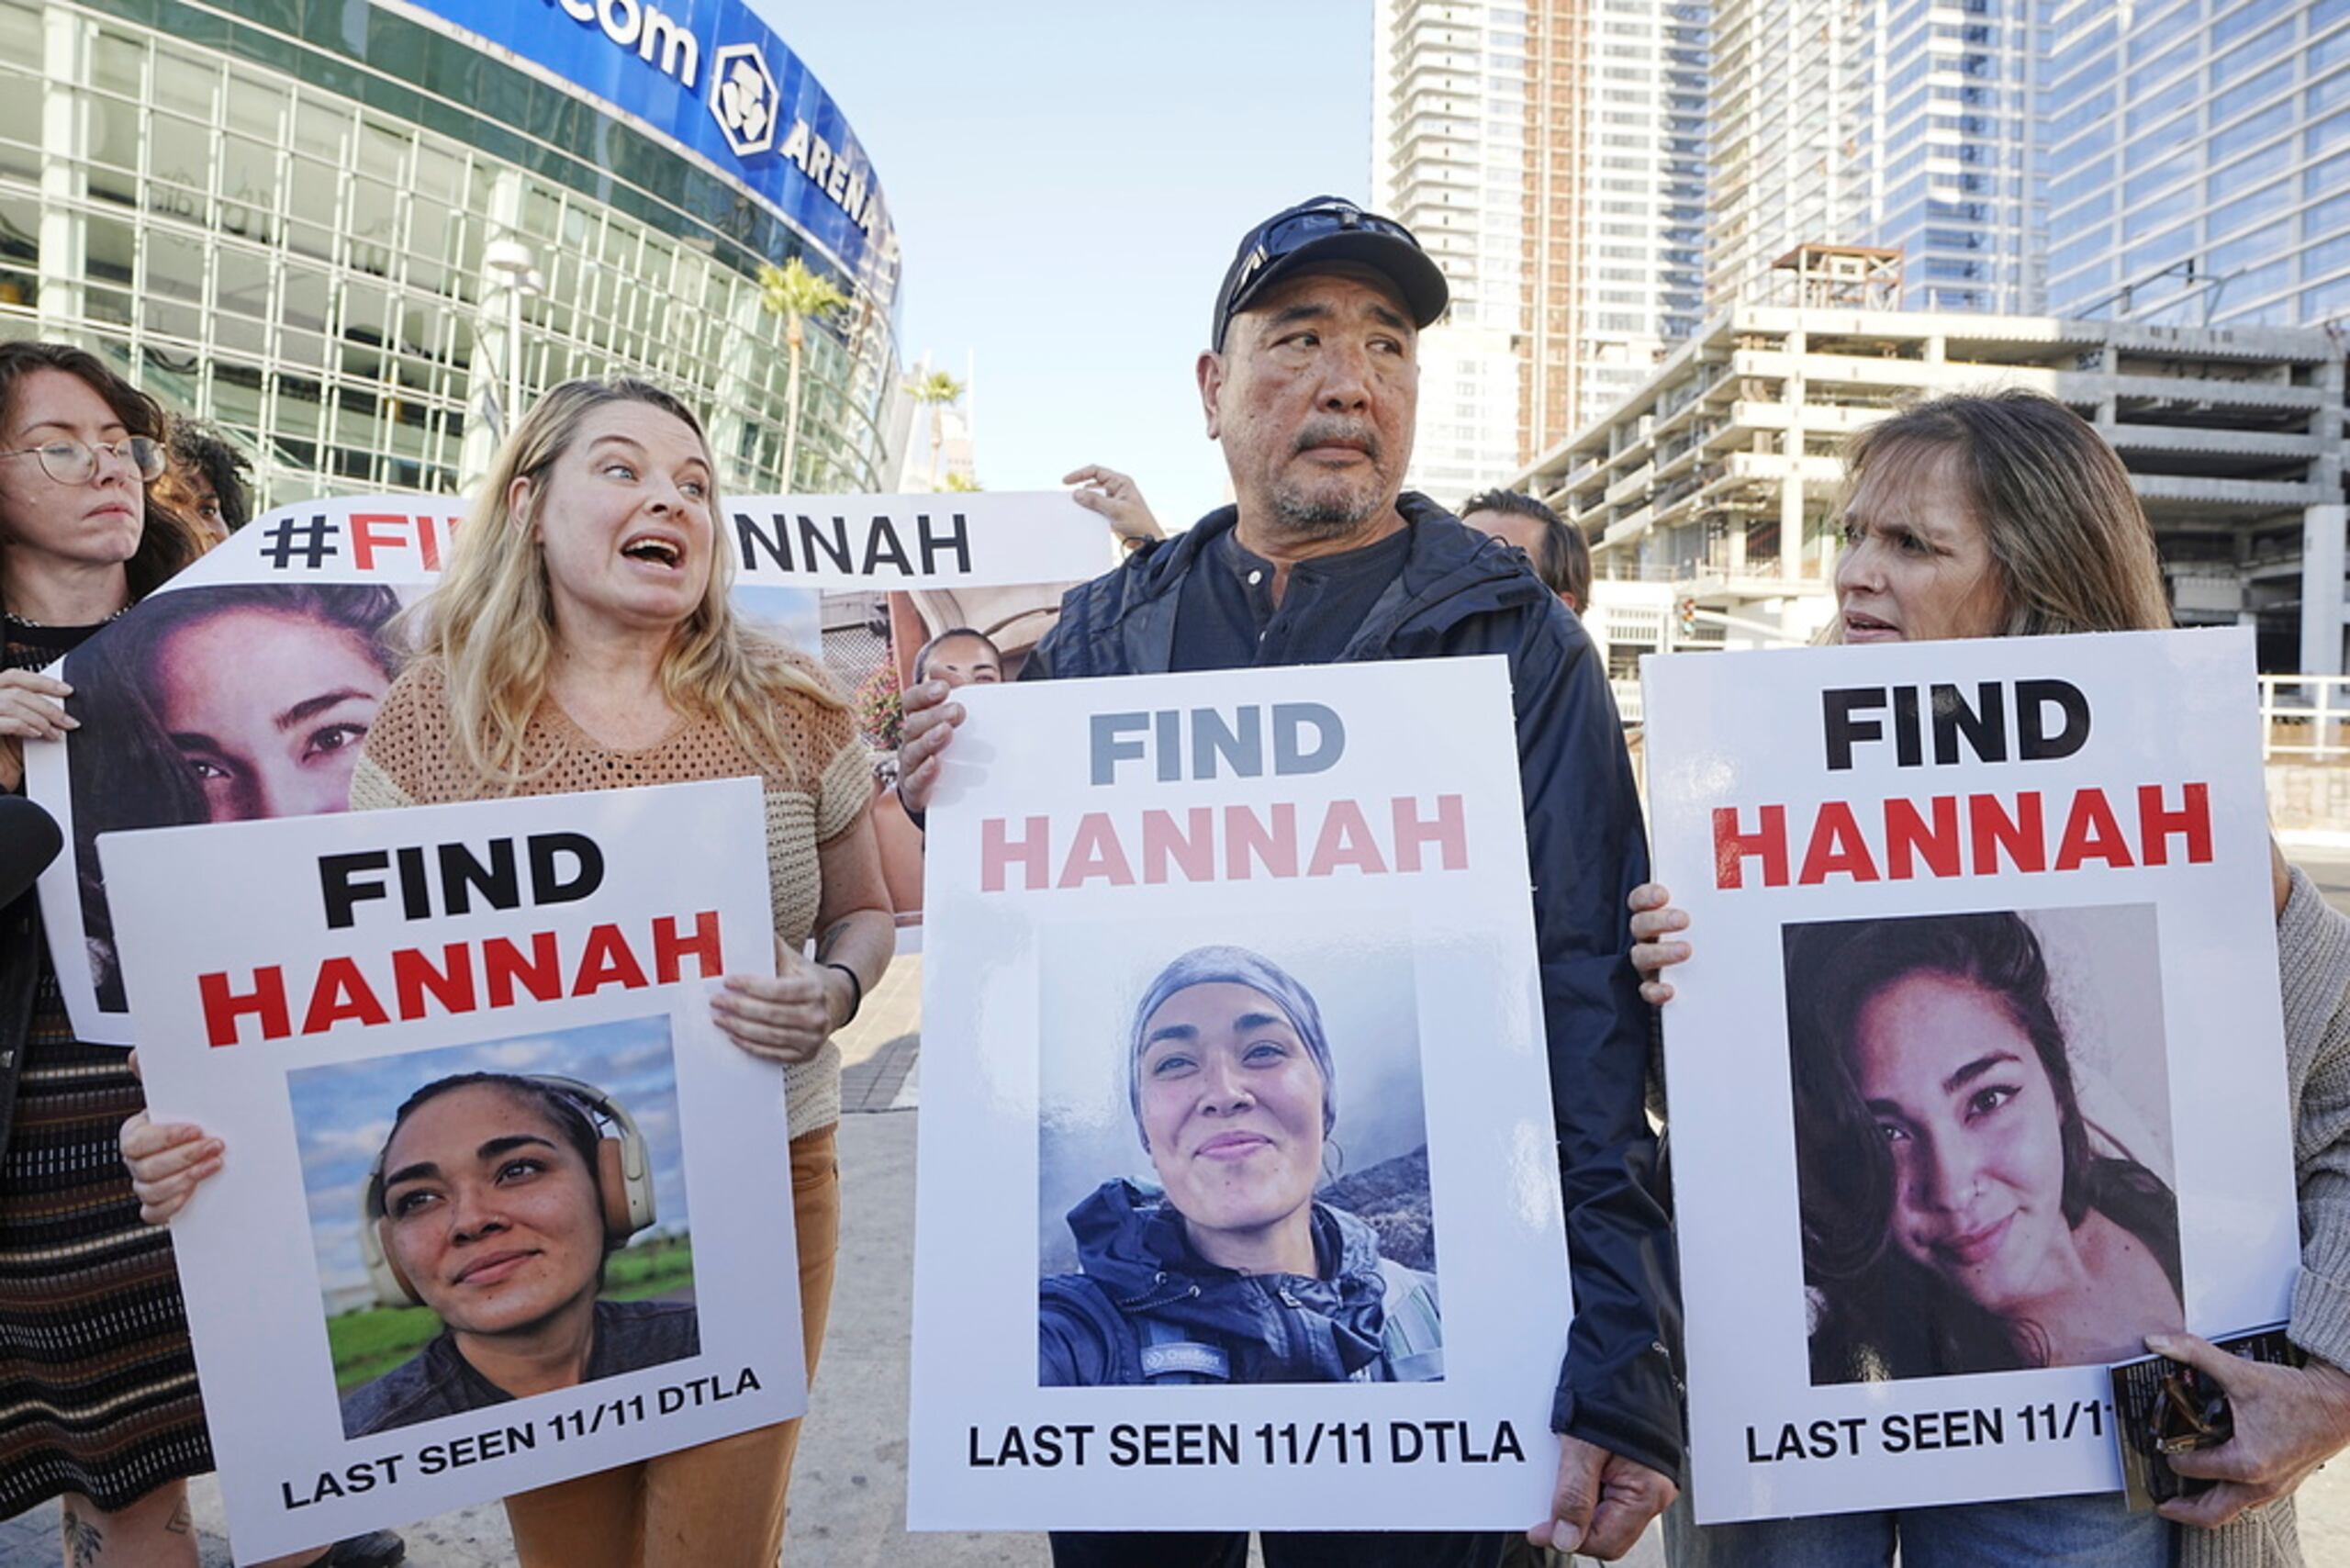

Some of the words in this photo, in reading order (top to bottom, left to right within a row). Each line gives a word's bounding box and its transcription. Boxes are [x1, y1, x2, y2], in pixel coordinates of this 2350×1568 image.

[778, 117, 876, 237] ARENA
[260, 514, 457, 571] #FI
[735, 513, 971, 576] NNAH
[1090, 702, 1346, 786] FIND
[1822, 678, 2091, 771] FIND
[318, 832, 605, 931] FIND
[980, 794, 1469, 892] HANNAH
[1712, 782, 2213, 890] HANNAH
[197, 910, 724, 1048] HANNAH
[281, 1453, 405, 1510] LAST
[418, 1421, 536, 1475] SEEN
[547, 1394, 645, 1442] 11/11
[657, 1367, 762, 1416] DTLA
[969, 1425, 1095, 1467] LAST
[1110, 1423, 1239, 1467] SEEN
[1255, 1422, 1372, 1465] 11/11
[1390, 1420, 1526, 1464] DTLA
[1746, 1417, 1867, 1463] LAST
[1881, 1407, 2004, 1454] SEEN
[2017, 1399, 2112, 1442] 11/1
